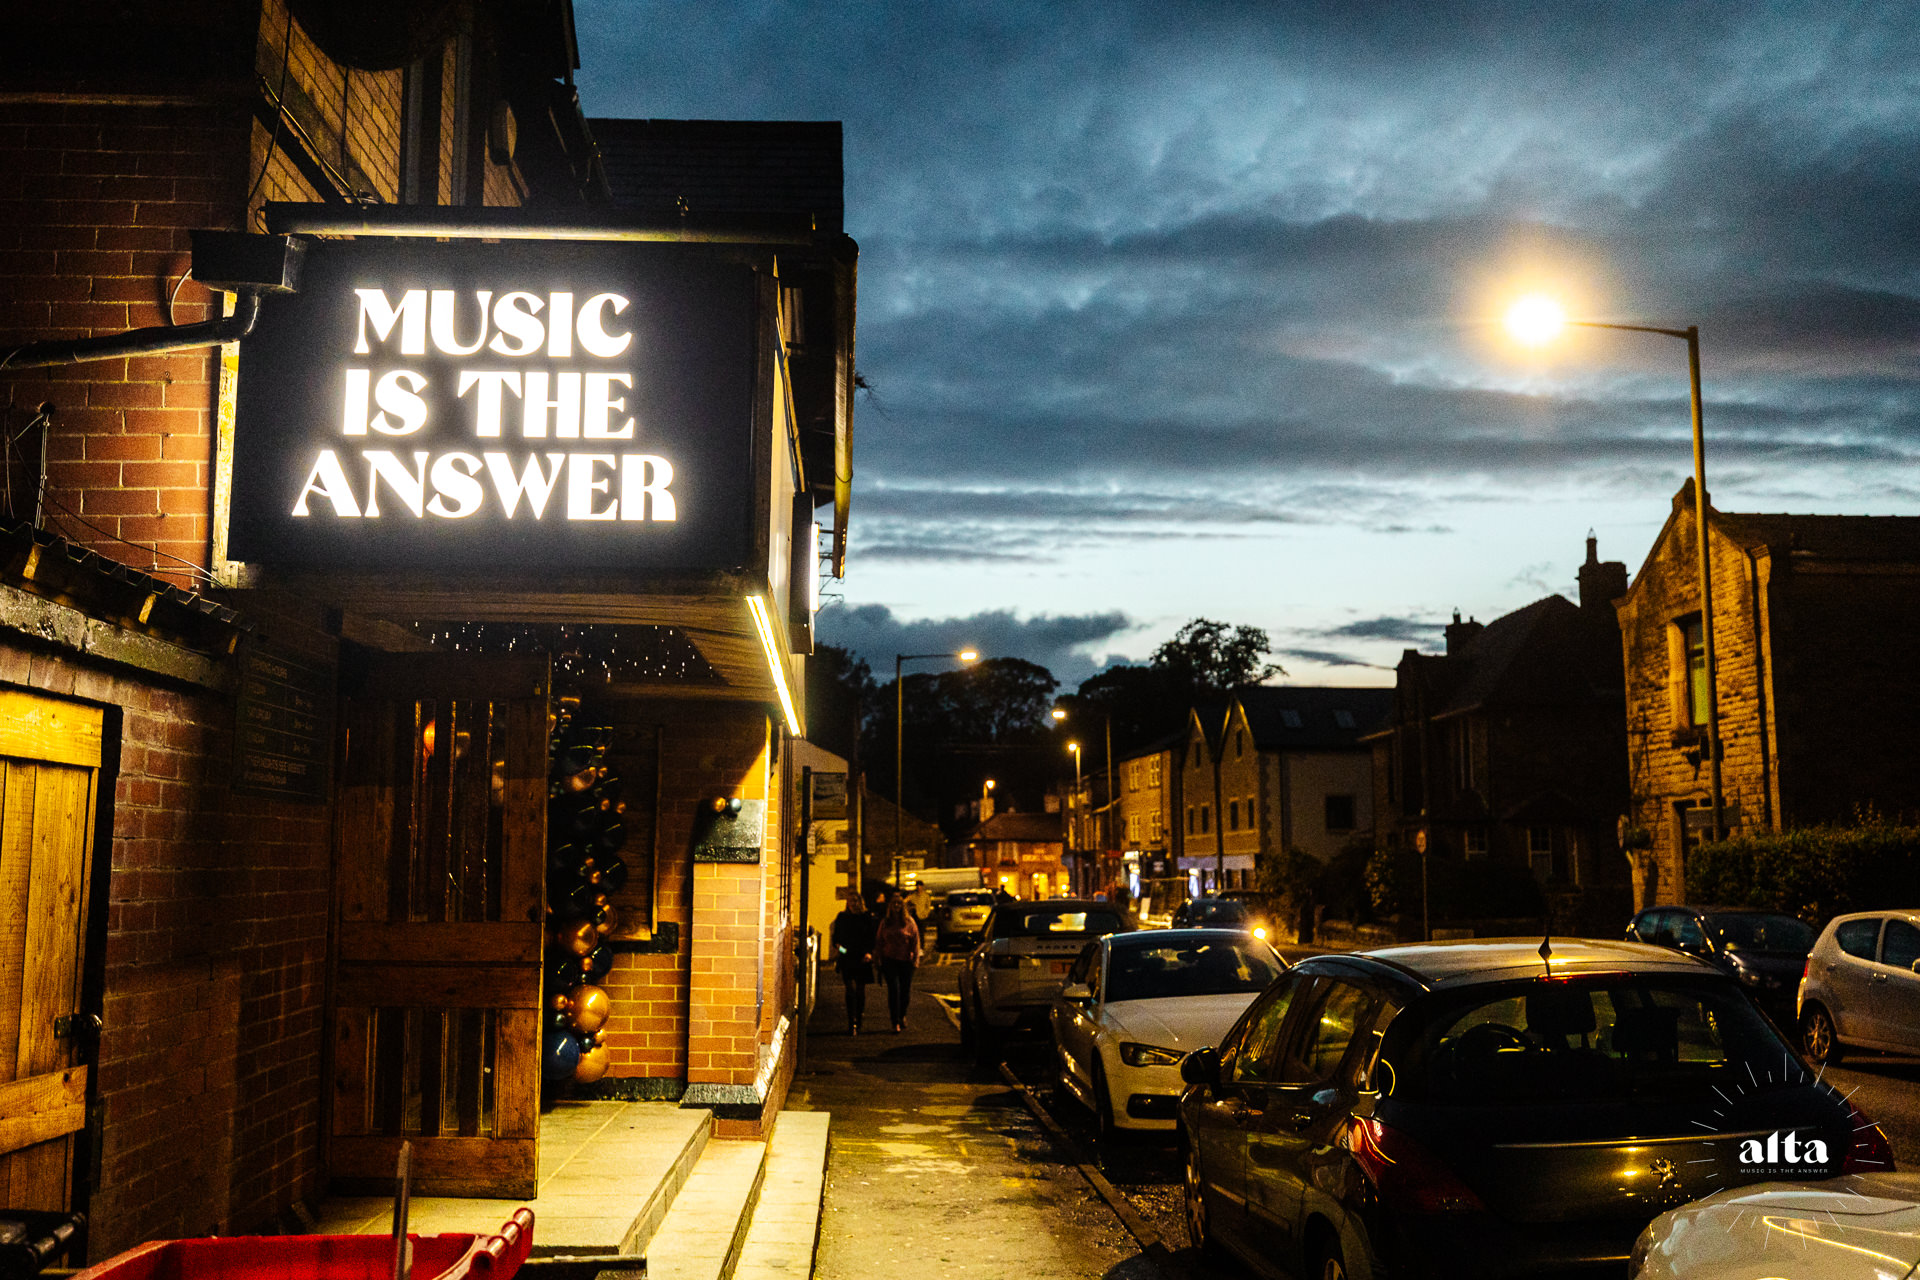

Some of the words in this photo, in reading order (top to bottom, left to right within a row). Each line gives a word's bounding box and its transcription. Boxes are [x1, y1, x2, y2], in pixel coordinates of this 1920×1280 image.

[353, 288, 633, 358] MUSIC
[342, 367, 428, 437] IS
[457, 369, 635, 440] THE
[291, 448, 677, 523] ANSWER
